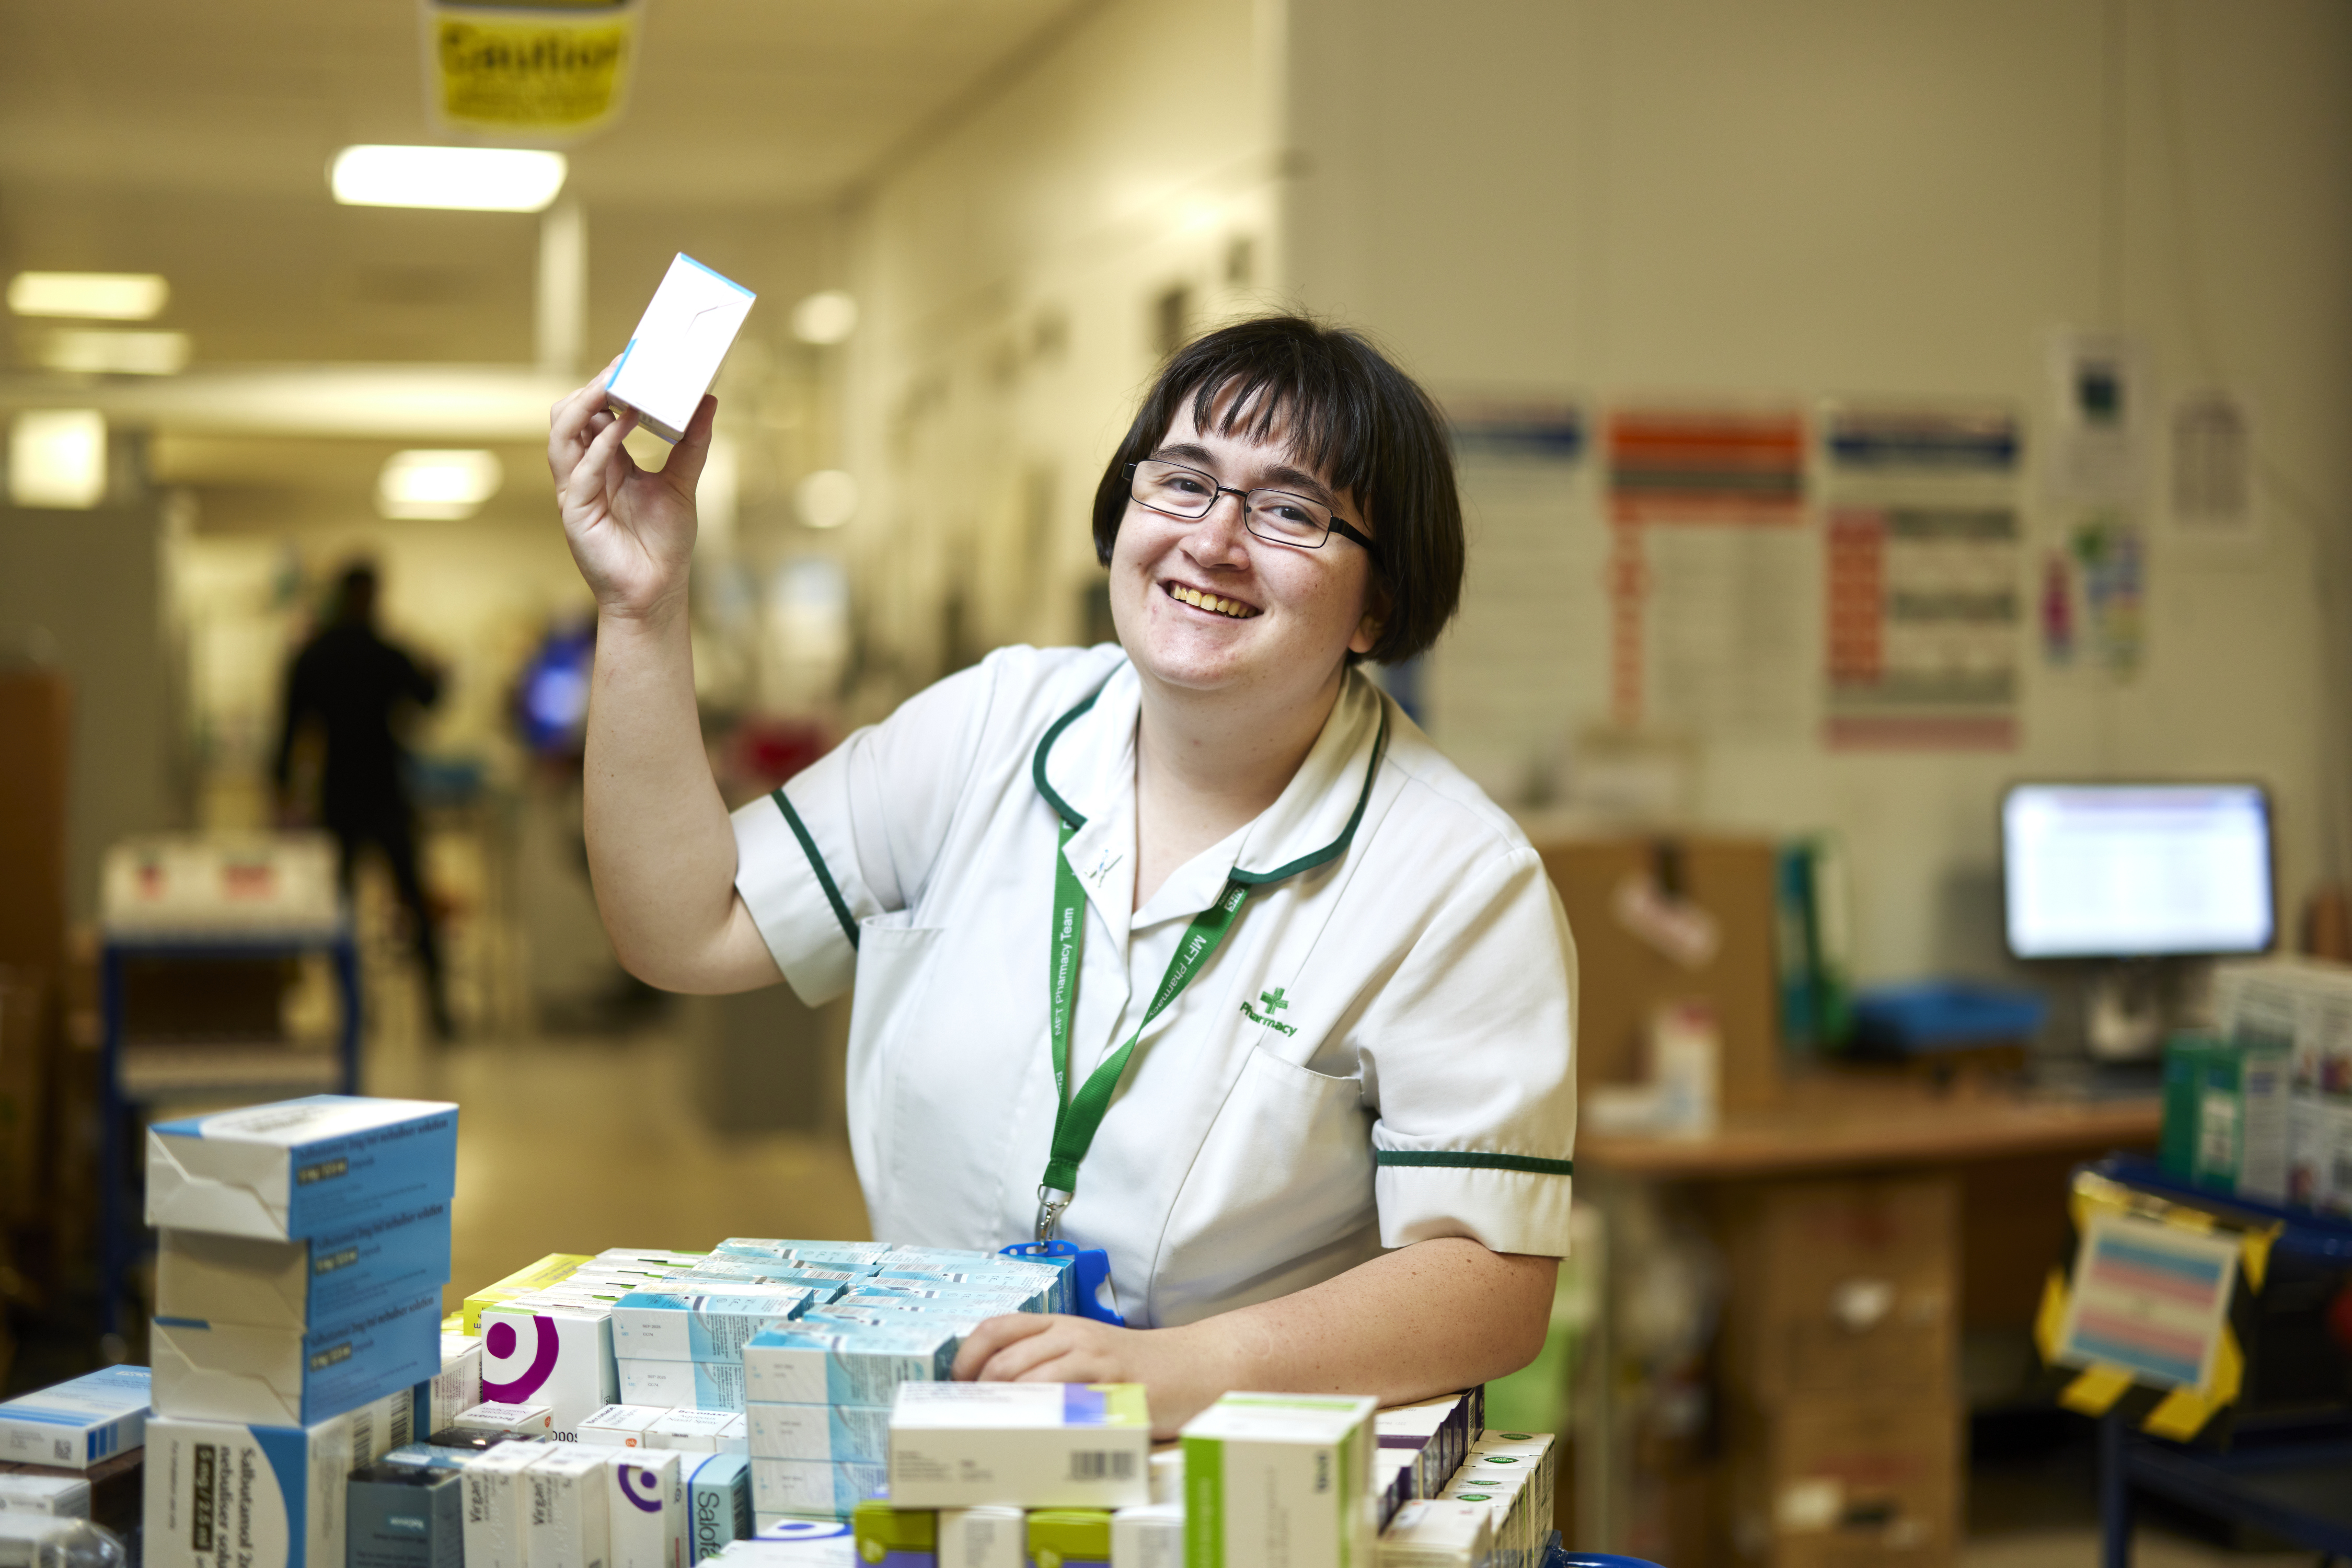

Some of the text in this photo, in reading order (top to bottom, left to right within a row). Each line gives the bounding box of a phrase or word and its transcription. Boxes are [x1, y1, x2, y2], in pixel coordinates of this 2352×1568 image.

[1225, 888, 1245, 912] NHS
[1060, 908, 1074, 941] Team
[1056, 944, 1073, 1004] Pharmacy
[1149, 935, 1206, 1018] MFT Pharmacy
[1240, 1001, 1298, 1037] Pharmacy
[418, 1119, 448, 1134] solution
[418, 1205, 443, 1220] solution
[409, 1297, 433, 1312] solution
[586, 1407, 616, 1423] Beconase
[218, 1446, 234, 1529] nebuliser
[239, 1448, 256, 1549] Salbutamol
[469, 1481, 483, 1523] Virgan
[532, 1483, 546, 1525] Virgan
[698, 1492, 721, 1560] Salofa
